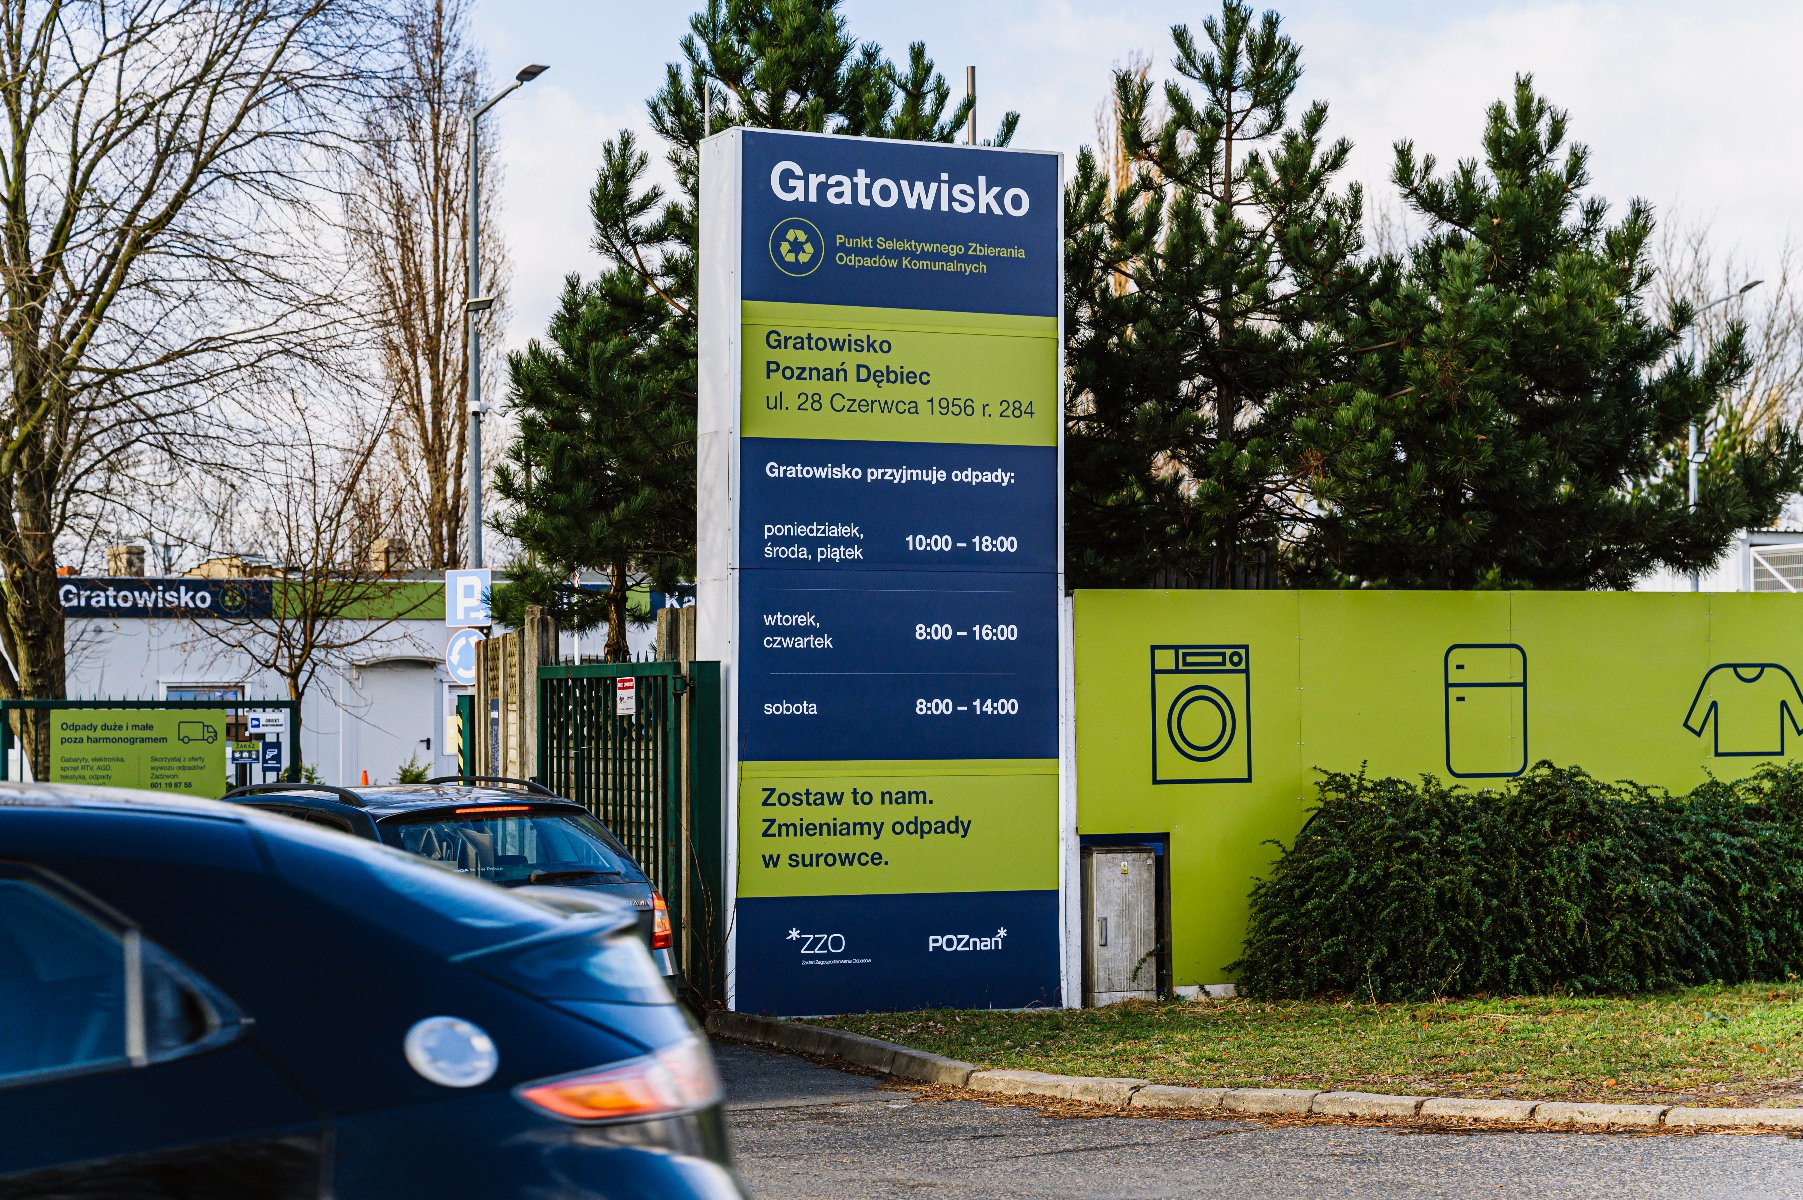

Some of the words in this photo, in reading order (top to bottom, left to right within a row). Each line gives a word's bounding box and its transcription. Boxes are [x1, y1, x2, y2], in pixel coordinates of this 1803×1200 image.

[771, 161, 1030, 216] Gratowisko
[836, 235, 873, 249] Punkt
[877, 237, 964, 254] Selektywnego
[968, 243, 1025, 258] Zbierania
[836, 253, 898, 268] Odpadów
[902, 258, 986, 275] Komunalnych
[766, 330, 892, 353] Gratowisko
[766, 361, 848, 382] Poznań
[856, 364, 930, 388] Dębiec
[766, 392, 788, 411] ul.
[797, 393, 822, 412] 28
[830, 394, 919, 415] Czerwca
[927, 397, 975, 416] 1956
[982, 403, 992, 417] r.
[999, 400, 1034, 418] 284
[766, 462, 862, 479] Gratowisko
[868, 466, 946, 483] przyjmuje
[952, 468, 1014, 486] odpady:
[764, 522, 864, 539] poniedziałek,
[906, 534, 952, 551] 10:00
[972, 536, 1017, 552] 18:00
[764, 543, 811, 560] środa,
[818, 544, 863, 562] piątek
[59, 584, 212, 608] Gratowisko
[457, 576, 481, 619] P
[764, 612, 820, 628] wtorek,
[764, 634, 833, 648] czwartek
[916, 624, 952, 640] 8:00
[972, 624, 1018, 641] 16:00
[764, 700, 817, 715] sobota
[916, 699, 952, 714] 8:00
[972, 699, 1018, 714] 14:00
[61, 722, 98, 732] Odpady
[101, 722, 122, 732] duże
[126, 723, 129, 731] i
[131, 723, 154, 731] małe
[61, 737, 83, 746] poza
[86, 736, 167, 746] harmonogramem
[150, 756, 181, 764] Skorzystaj
[89, 774, 112, 782] odpady
[762, 788, 844, 806] Zostaw
[852, 788, 873, 805] to
[881, 791, 934, 804] nam.
[762, 818, 884, 839] Zmieniamy
[892, 816, 971, 838] odpady
[762, 854, 780, 868] w
[788, 851, 888, 868] surowce.
